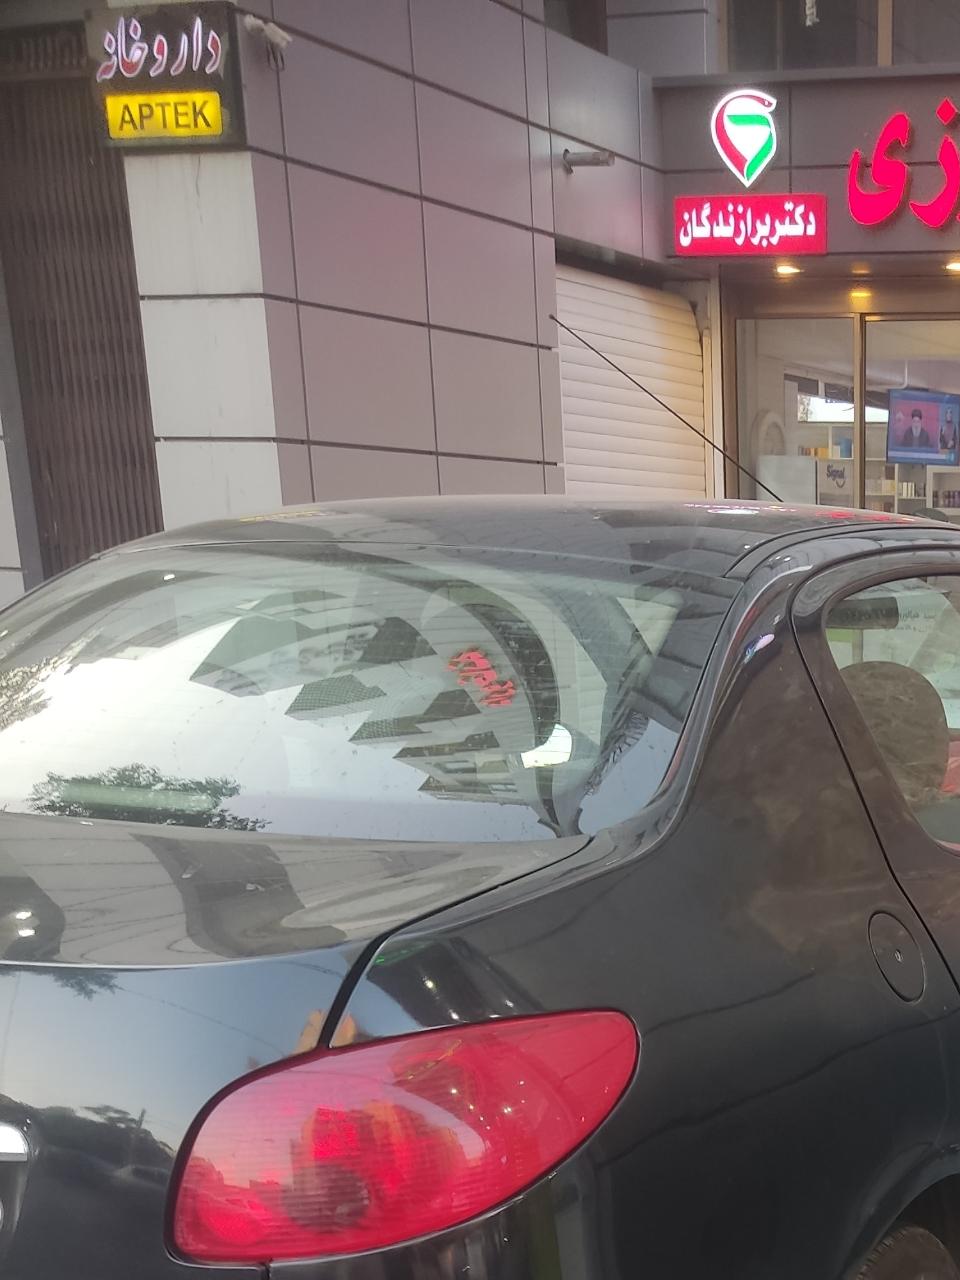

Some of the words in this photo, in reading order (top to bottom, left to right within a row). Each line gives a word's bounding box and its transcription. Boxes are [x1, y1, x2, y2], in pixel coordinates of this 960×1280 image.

[96, 16, 222, 83] داروخانه
[118, 100, 212, 131] APTEK
[679, 202, 771, 248] برازندگان
[768, 201, 817, 247] دکتر
